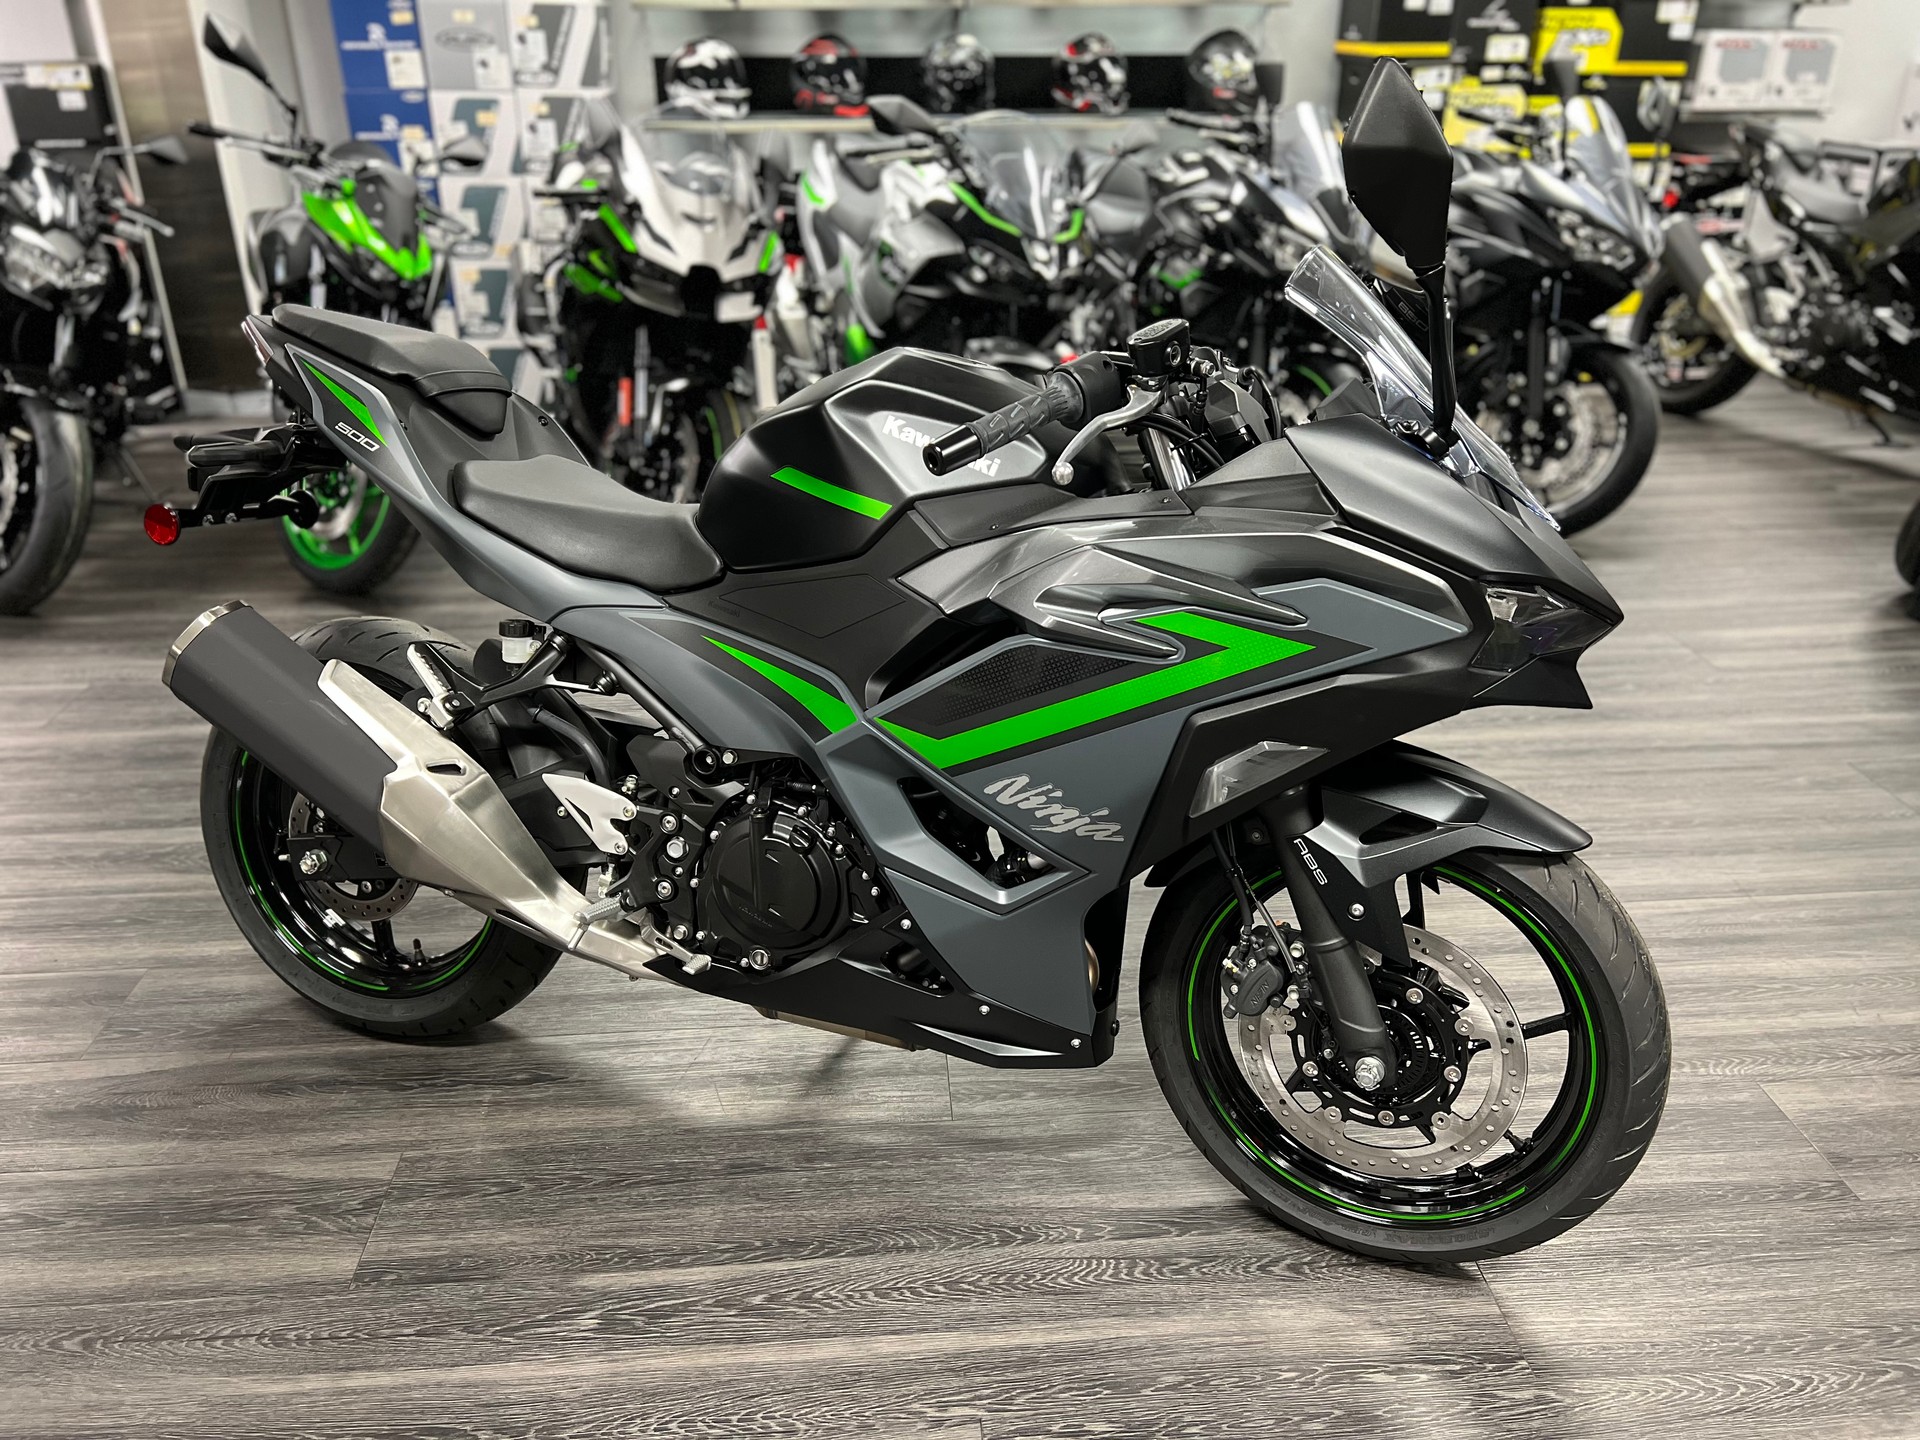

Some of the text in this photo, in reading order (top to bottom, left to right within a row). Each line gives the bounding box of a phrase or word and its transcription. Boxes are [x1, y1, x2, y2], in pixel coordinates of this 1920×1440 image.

[334, 421, 380, 452] 500
[882, 414, 1001, 477] Kawki
[983, 773, 1125, 842] Ninja
[1293, 838, 1328, 885] ABS
